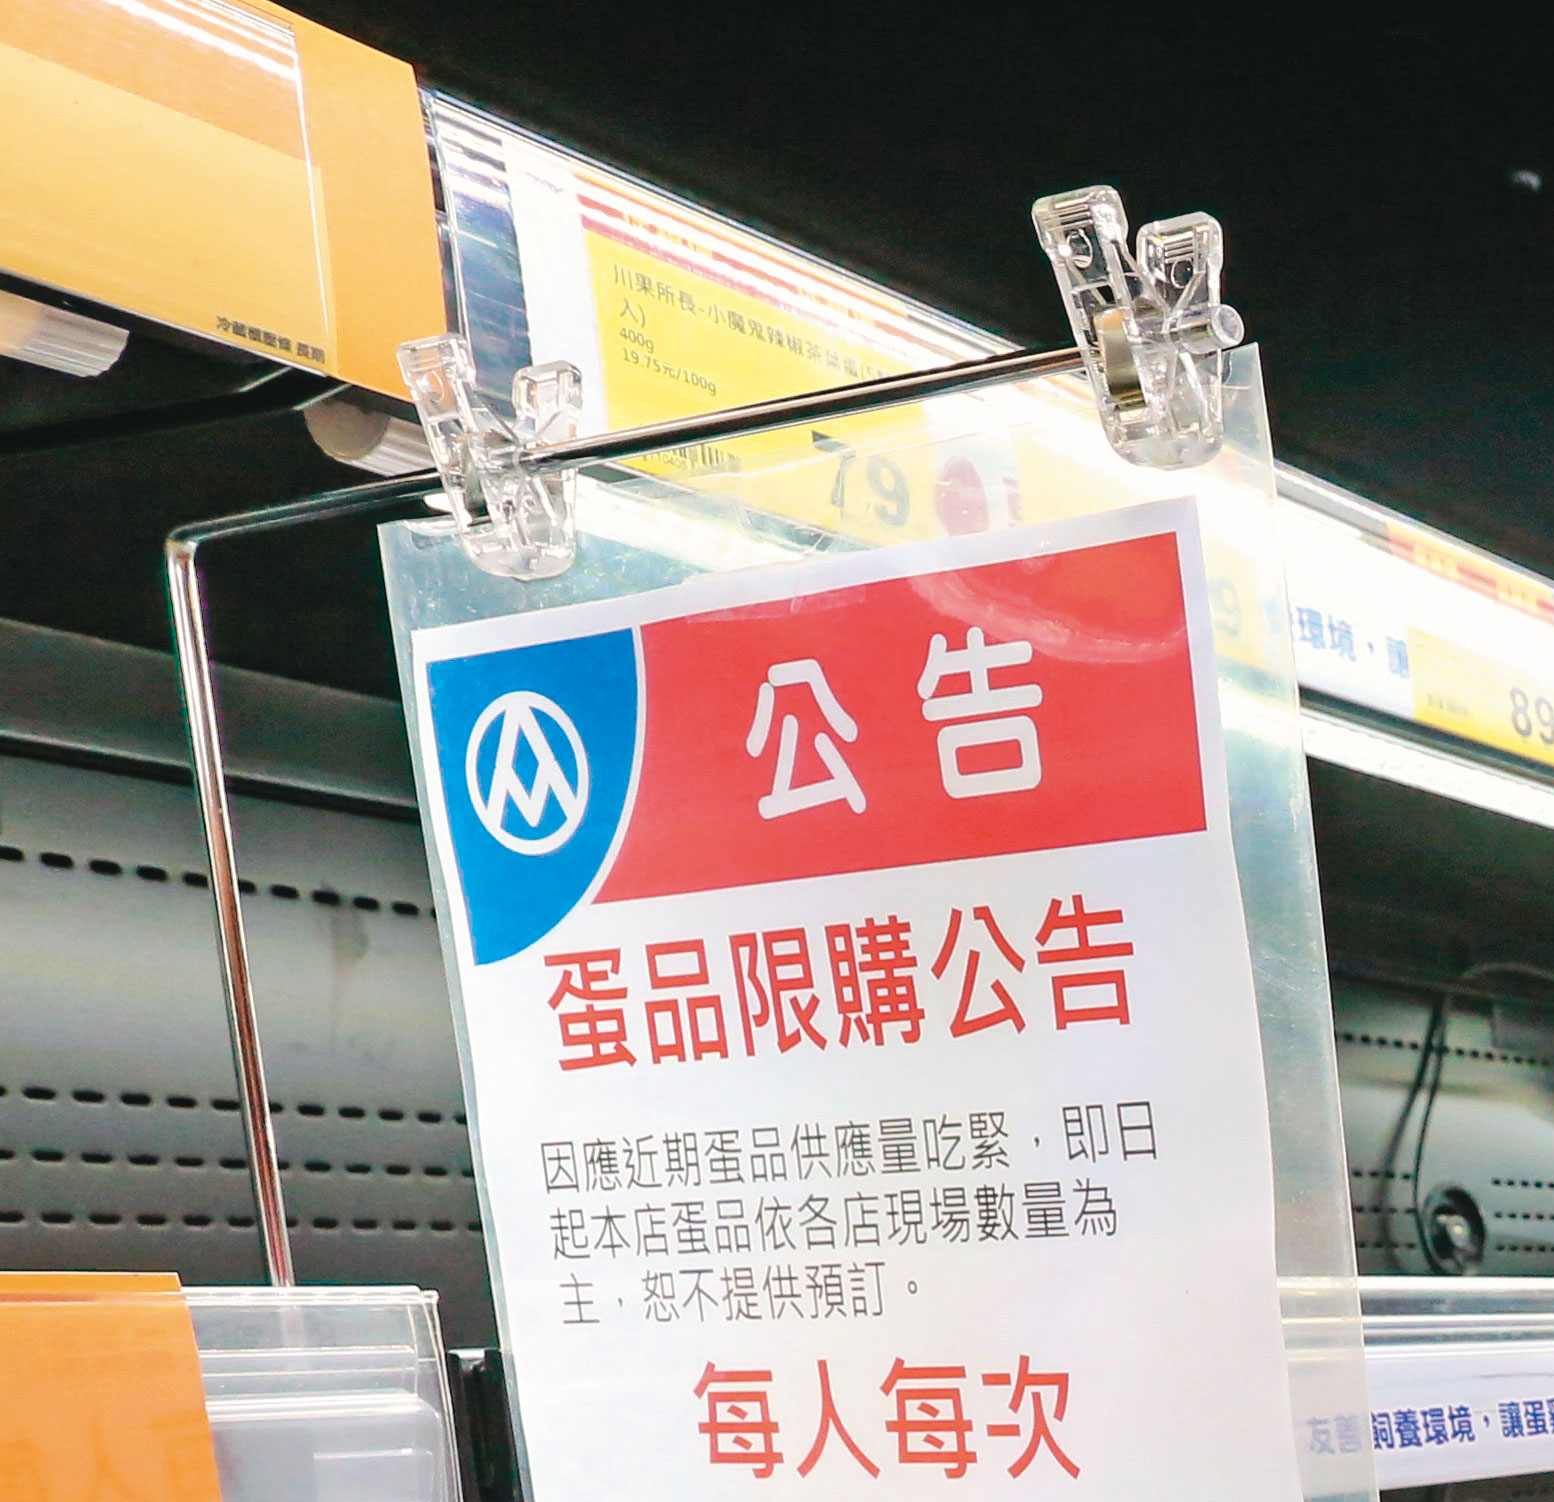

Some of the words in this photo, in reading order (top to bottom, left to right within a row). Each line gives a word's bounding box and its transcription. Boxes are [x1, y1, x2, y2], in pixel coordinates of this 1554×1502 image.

[619, 327, 655, 354] 400g
[745, 624, 1044, 821] 公告
[542, 893, 1136, 1073] 蛋品限購公告
[548, 1177, 1118, 1263] 起本店蛋品依各店現場數量為
[691, 1355, 1082, 1481] 每人每次
